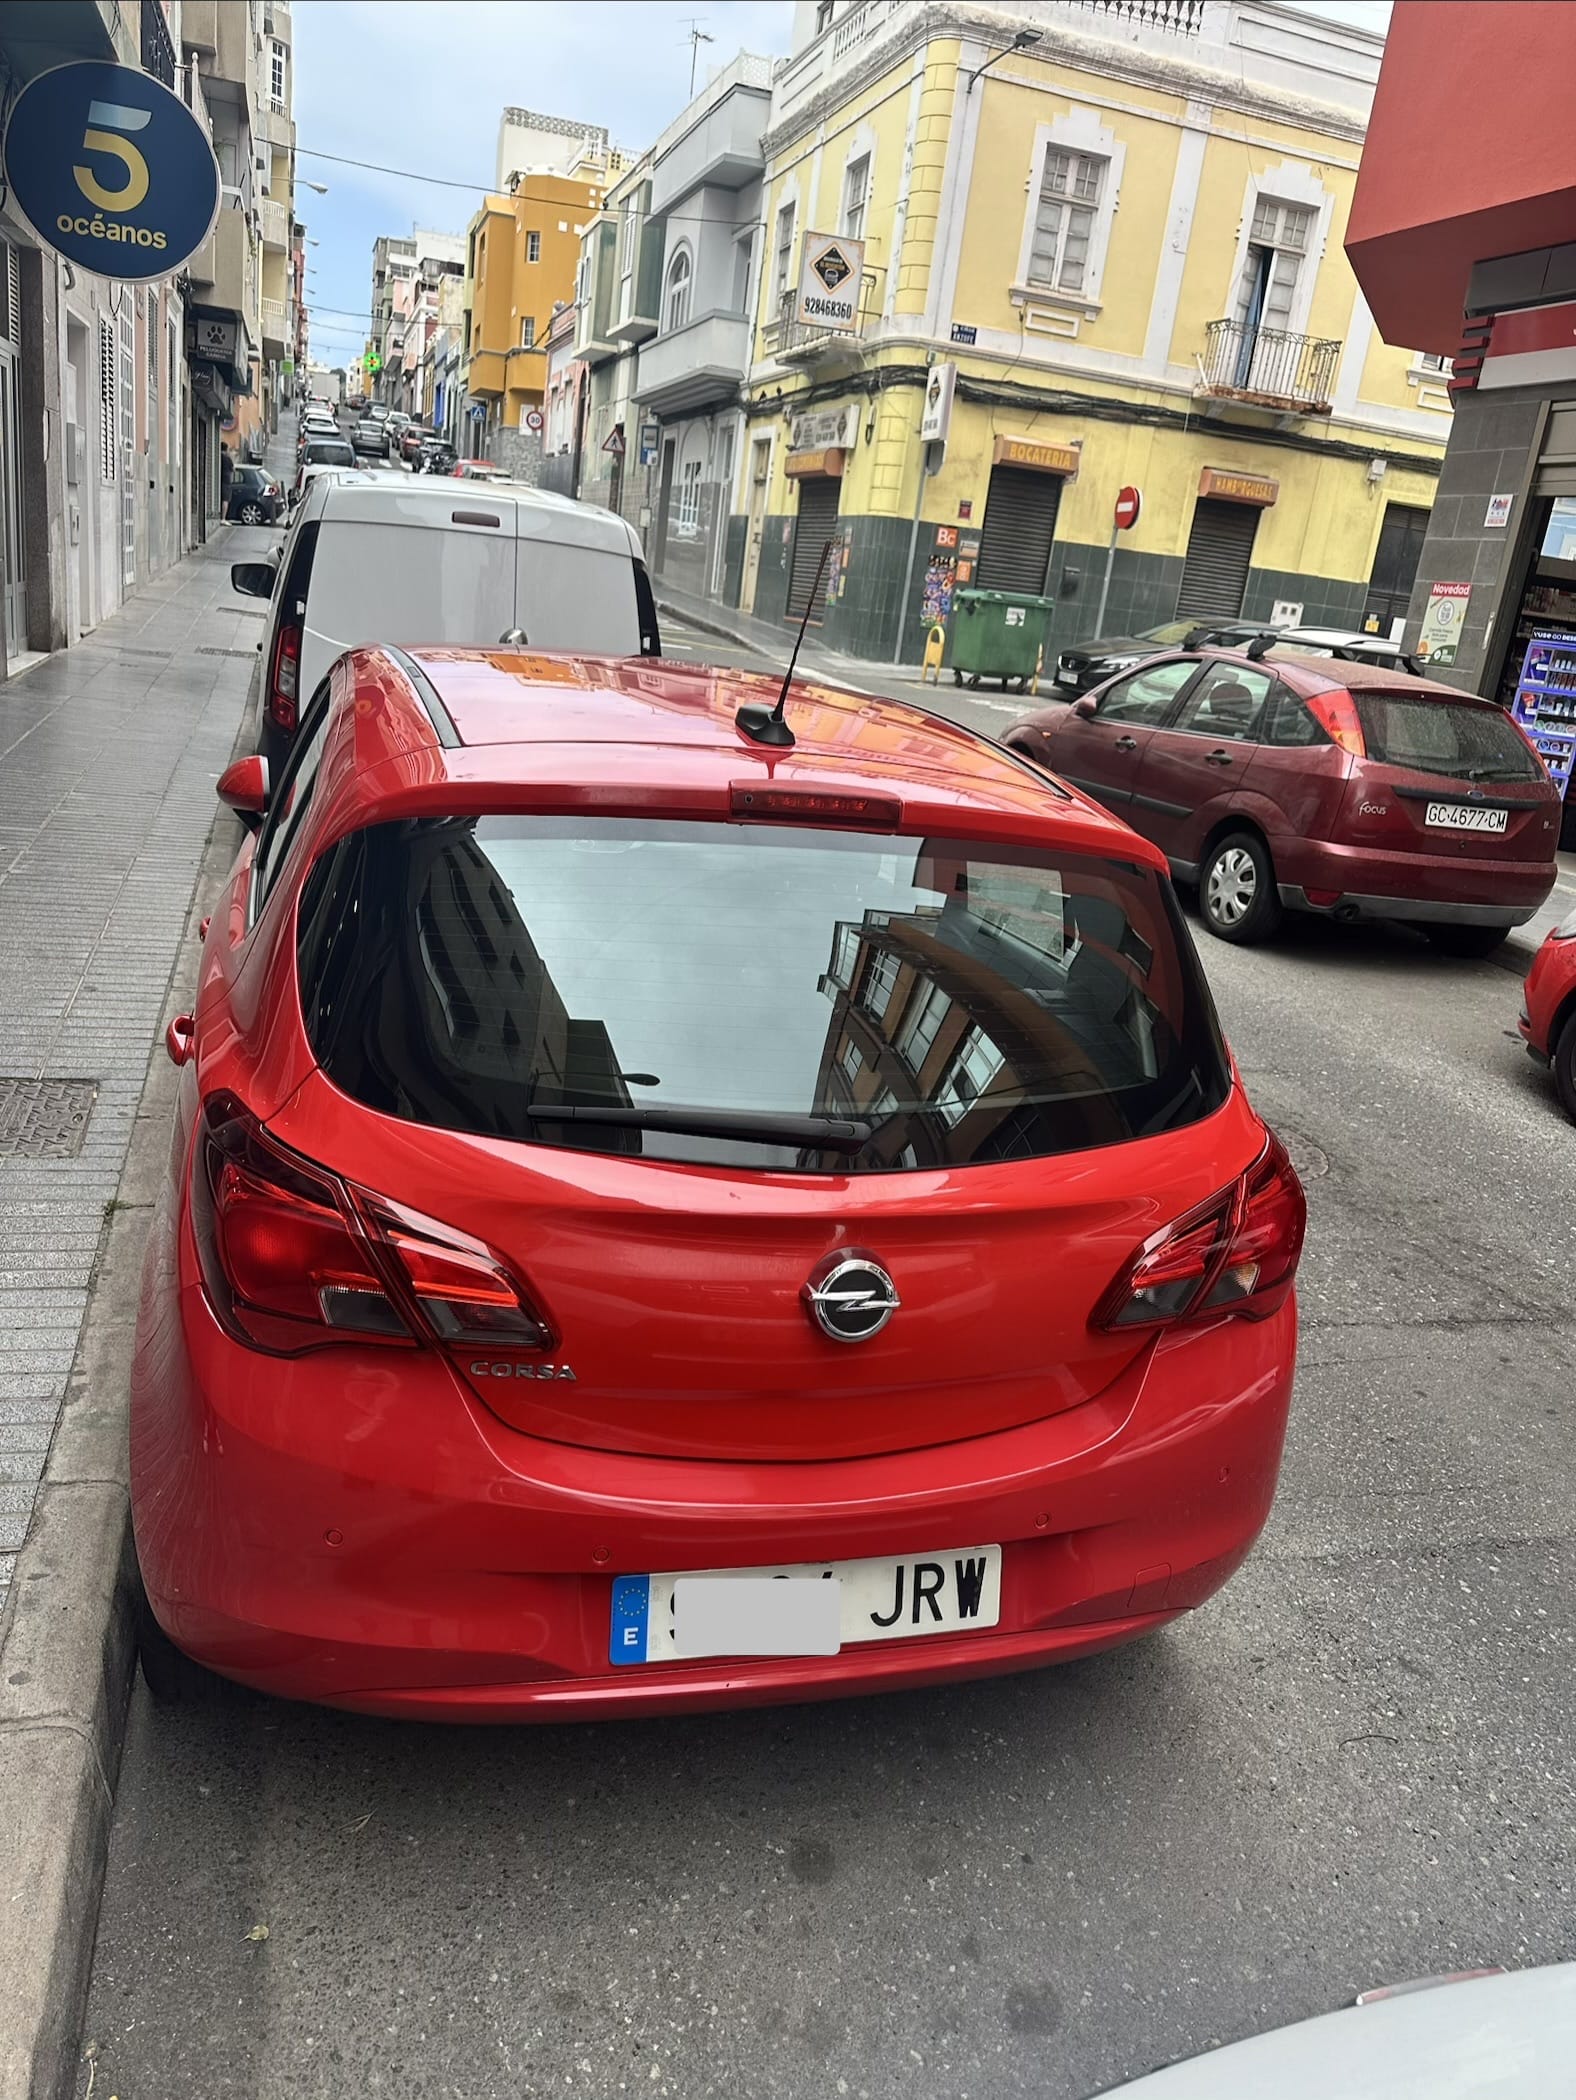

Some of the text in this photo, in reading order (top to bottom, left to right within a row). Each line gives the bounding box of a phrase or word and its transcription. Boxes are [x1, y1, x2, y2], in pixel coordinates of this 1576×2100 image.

[73, 100, 151, 212] 5
[57, 213, 167, 250] océanos
[804, 296, 852, 320] 928468360
[1009, 443, 1072, 468] BOCATERIA
[1432, 583, 1471, 596] Novedad
[470, 1362, 577, 1380] CORSA
[870, 1556, 987, 1627] JRW
[623, 1627, 639, 1645] E
